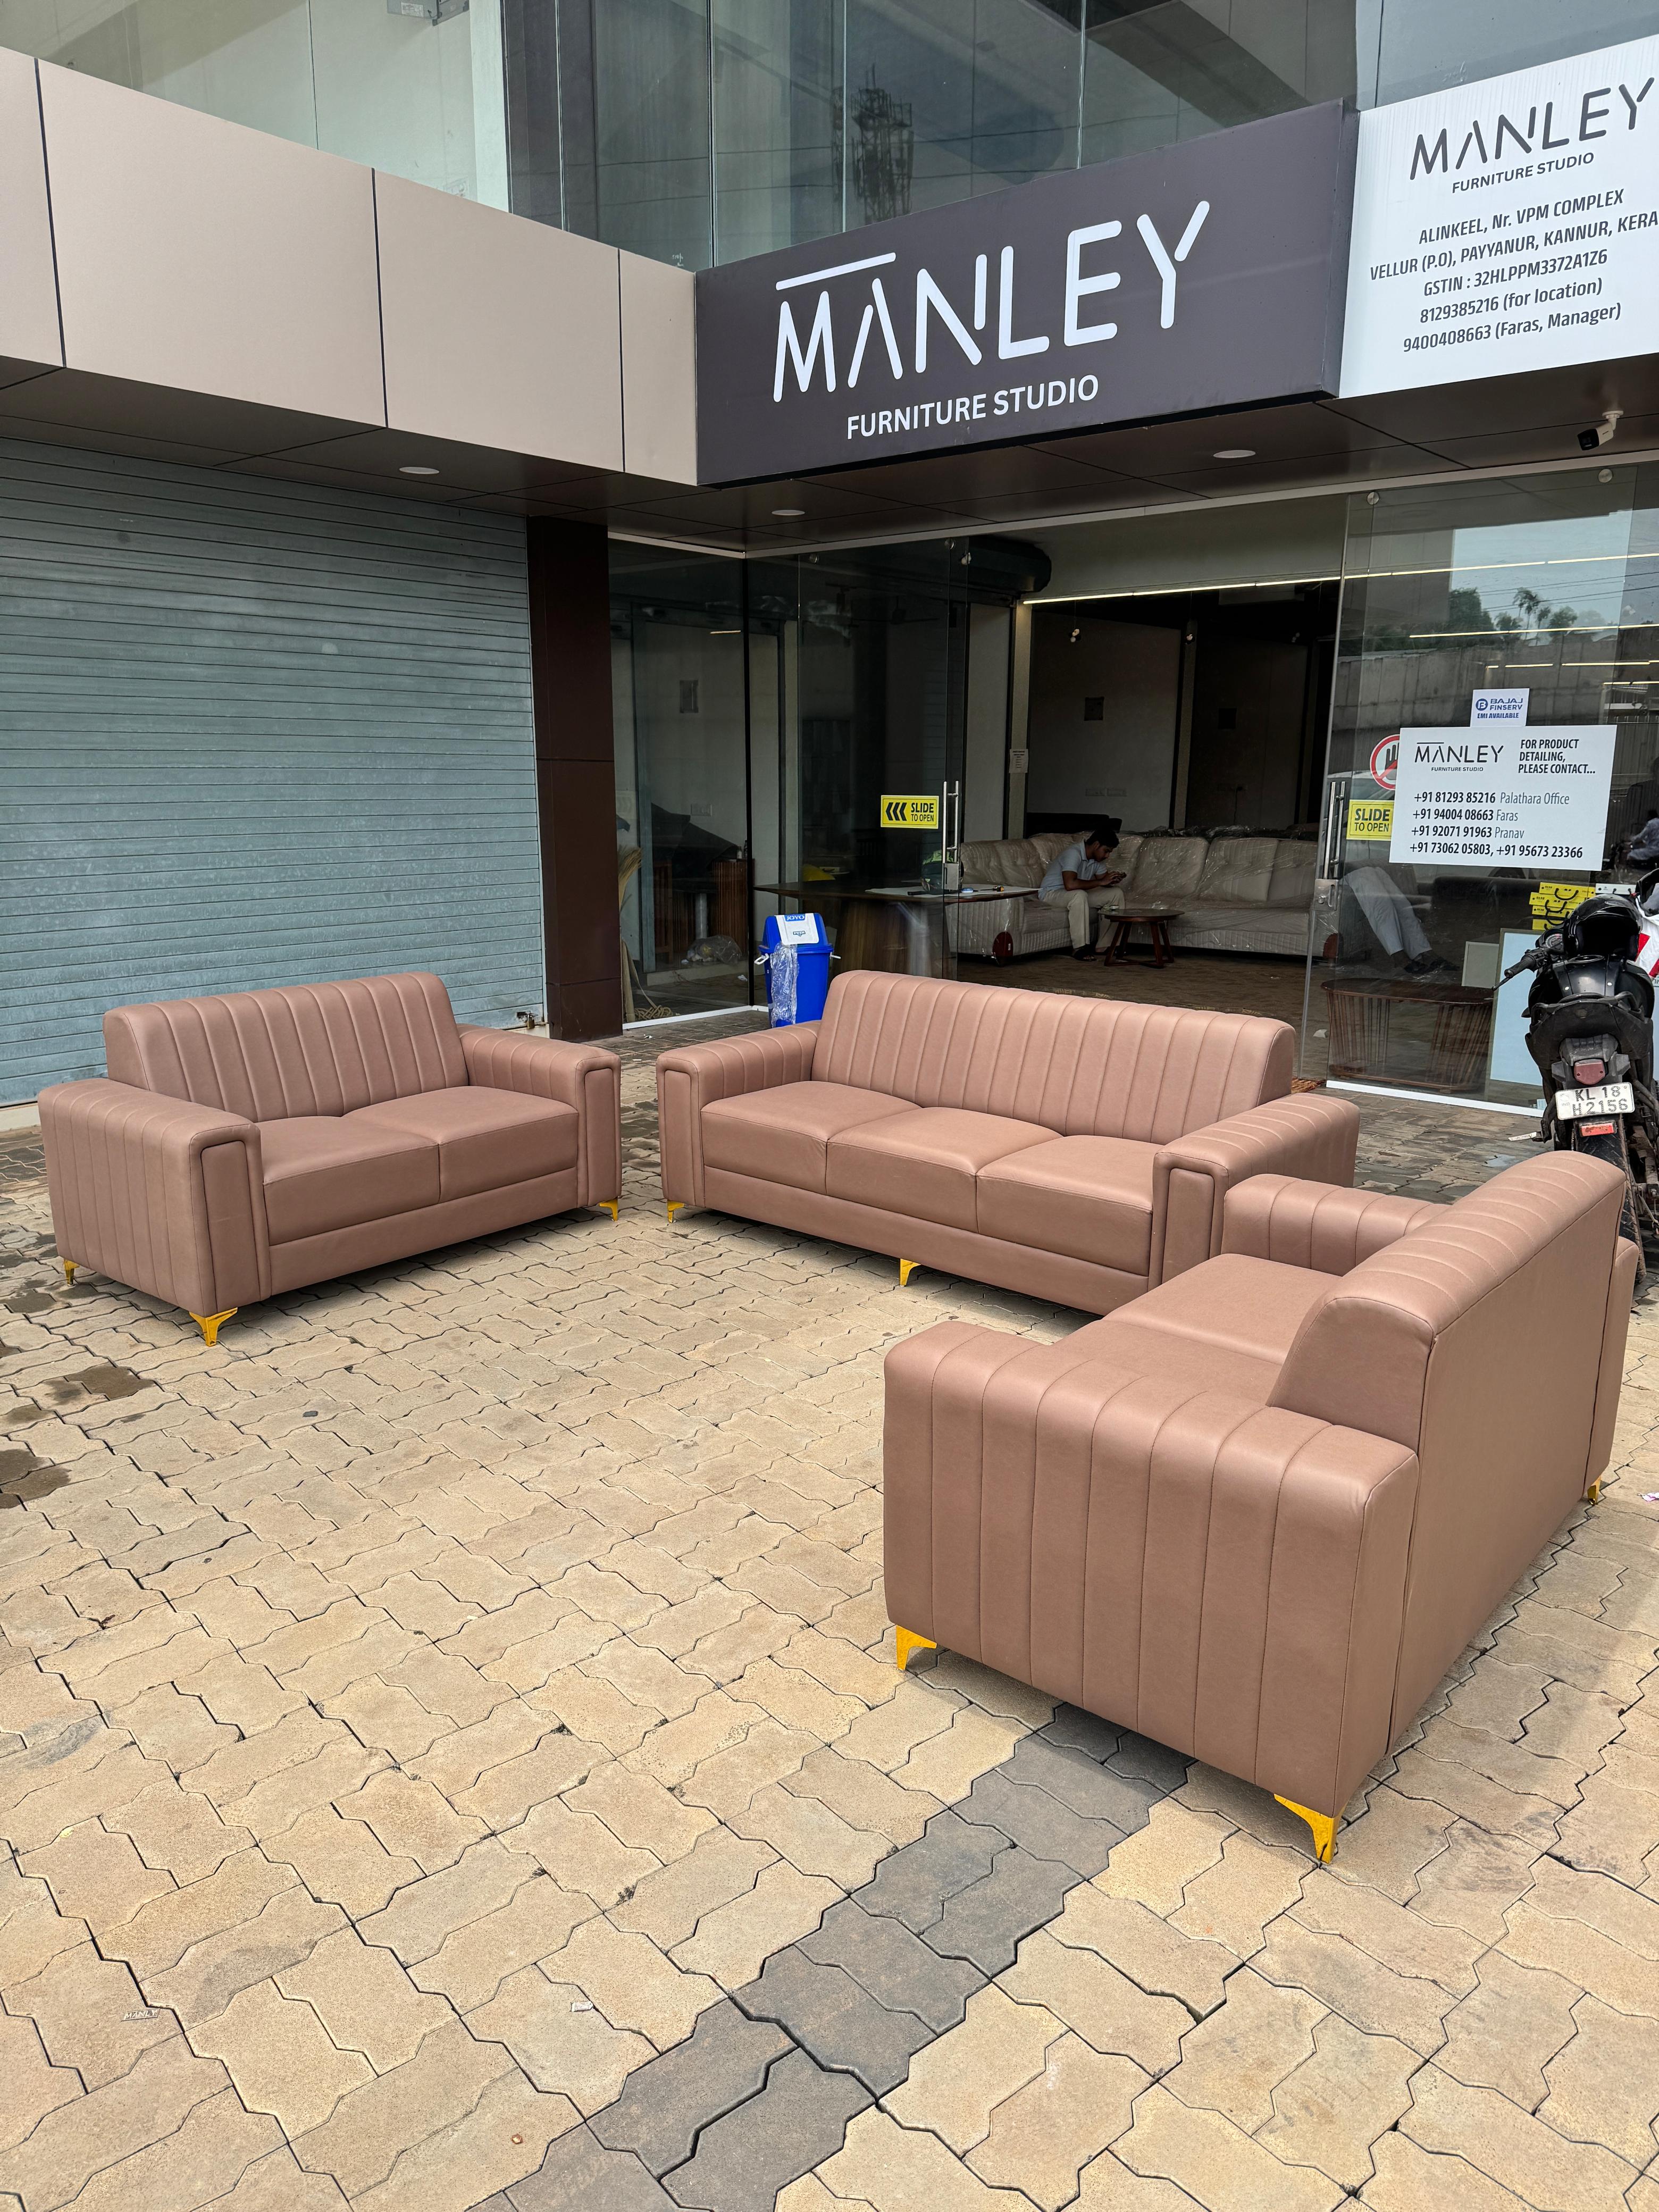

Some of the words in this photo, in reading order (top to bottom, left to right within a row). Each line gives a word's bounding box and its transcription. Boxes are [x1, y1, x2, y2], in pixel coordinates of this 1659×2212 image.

[1410, 77, 1654, 180] MANLEY
[1452, 165, 1534, 194] FURNITURE
[1537, 152, 1594, 174] STUDIO
[1419, 219, 1487, 244] ALINKEEL,
[1493, 214, 1512, 229] Nr.
[1516, 204, 1549, 224] VPM
[1554, 189, 1624, 216] COMPLEX
[1370, 258, 1418, 280] VELLUR
[1422, 251, 1456, 272] (P.O),
[1461, 235, 1539, 263] PAYYANUR,
[1544, 221, 1612, 246] KANNUR,
[1618, 211, 1658, 232] KERA
[1424, 276, 1463, 296] GSTIN
[1474, 249, 1607, 287] 32HLPPM3372A1Z6
[773, 200, 1210, 403] MANLEY
[1420, 296, 1499, 323] 8129385216
[1503, 292, 1531, 311] (for
[1535, 278, 1602, 304] location)
[1403, 324, 1491, 352] 9400408663
[1495, 320, 1543, 339] (Faras,
[1547, 303, 1621, 329] Manager)
[847, 393, 986, 440] FURNITURE
[993, 374, 1099, 415] STUDIO
[1520, 739, 1539, 749] FOR
[1540, 739, 1579, 749] PRODUCT
[1414, 742, 1504, 763] MANLEY
[1519, 752, 1565, 763] DETAILING,
[1518, 764, 1549, 774] PLEASE
[1550, 764, 1596, 774] CONTACT...
[1414, 792, 1432, 803] +91
[1435, 792, 1464, 803] 81293
[1465, 792, 1496, 803] 85216
[1500, 792, 1541, 804] Palathara
[1544, 792, 1570, 805] Office
[911, 802, 934, 813] SLIDE
[1355, 808, 1390, 822] SLIDE
[1413, 809, 1431, 819] +91
[1434, 809, 1463, 820] 94004
[1464, 809, 1494, 820] 08663
[1496, 809, 1518, 821] Faras
[1355, 822, 1365, 832] TO
[1367, 823, 1389, 832] OPEN
[1411, 825, 1430, 836] +91
[1432, 826, 1460, 837] 92071
[1463, 826, 1492, 837] 91963
[1495, 827, 1524, 839] Pranav
[1410, 842, 1428, 853] +91
[1431, 842, 1460, 854] 73062
[1462, 843, 1494, 857] 05803,
[1496, 844, 1516, 856] +91
[1519, 845, 1549, 857] 95673
[1551, 846, 1583, 858] 23366
[1575, 1089, 1595, 1101] KL
[1602, 1086, 1620, 1098] 18
